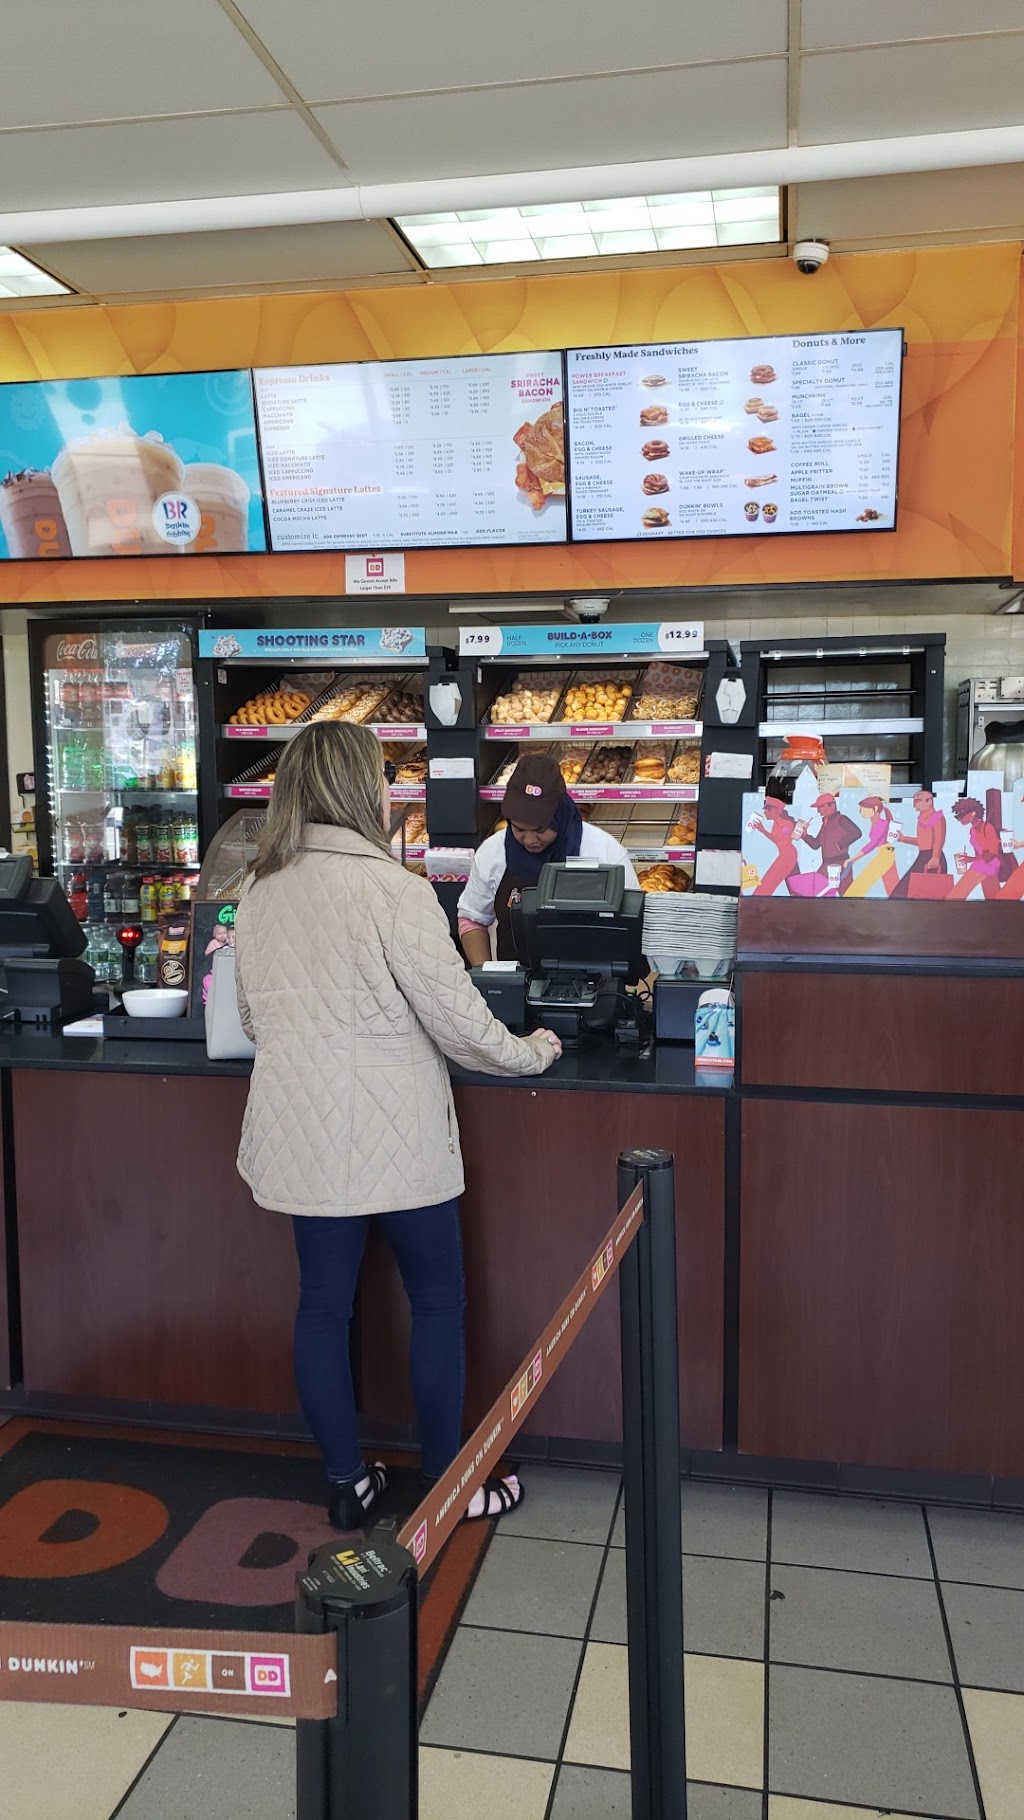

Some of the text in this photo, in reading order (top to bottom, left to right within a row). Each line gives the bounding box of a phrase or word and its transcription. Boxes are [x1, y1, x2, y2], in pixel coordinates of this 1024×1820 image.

[792, 338, 829, 348] Donuts
[840, 337, 866, 346] More
[576, 347, 698, 361] Freshly Made Sandwiches
[260, 374, 330, 386] Espresso Drinks
[511, 378, 560, 388] SRIRACHA
[518, 388, 553, 397] BACON
[310, 487, 352, 496] Signature
[163, 501, 187, 519] BR
[257, 635, 365, 646] SHOOTING STAR
[465, 635, 490, 644] $7.99
[665, 629, 698, 640] $12.99
[526, 784, 542, 796] DD
[435, 1484, 460, 1526] AMERICA
[461, 1462, 474, 1488] RUNS
[476, 1450, 483, 1466] ON
[365, 1550, 388, 1572] Beltrac
[354, 1562, 368, 1574] Lavi
[346, 1565, 370, 1589] Industries
[8, 1656, 83, 1674] DUNKIN'
[221, 1668, 233, 1677] ON
[257, 1670, 278, 1682] DD
